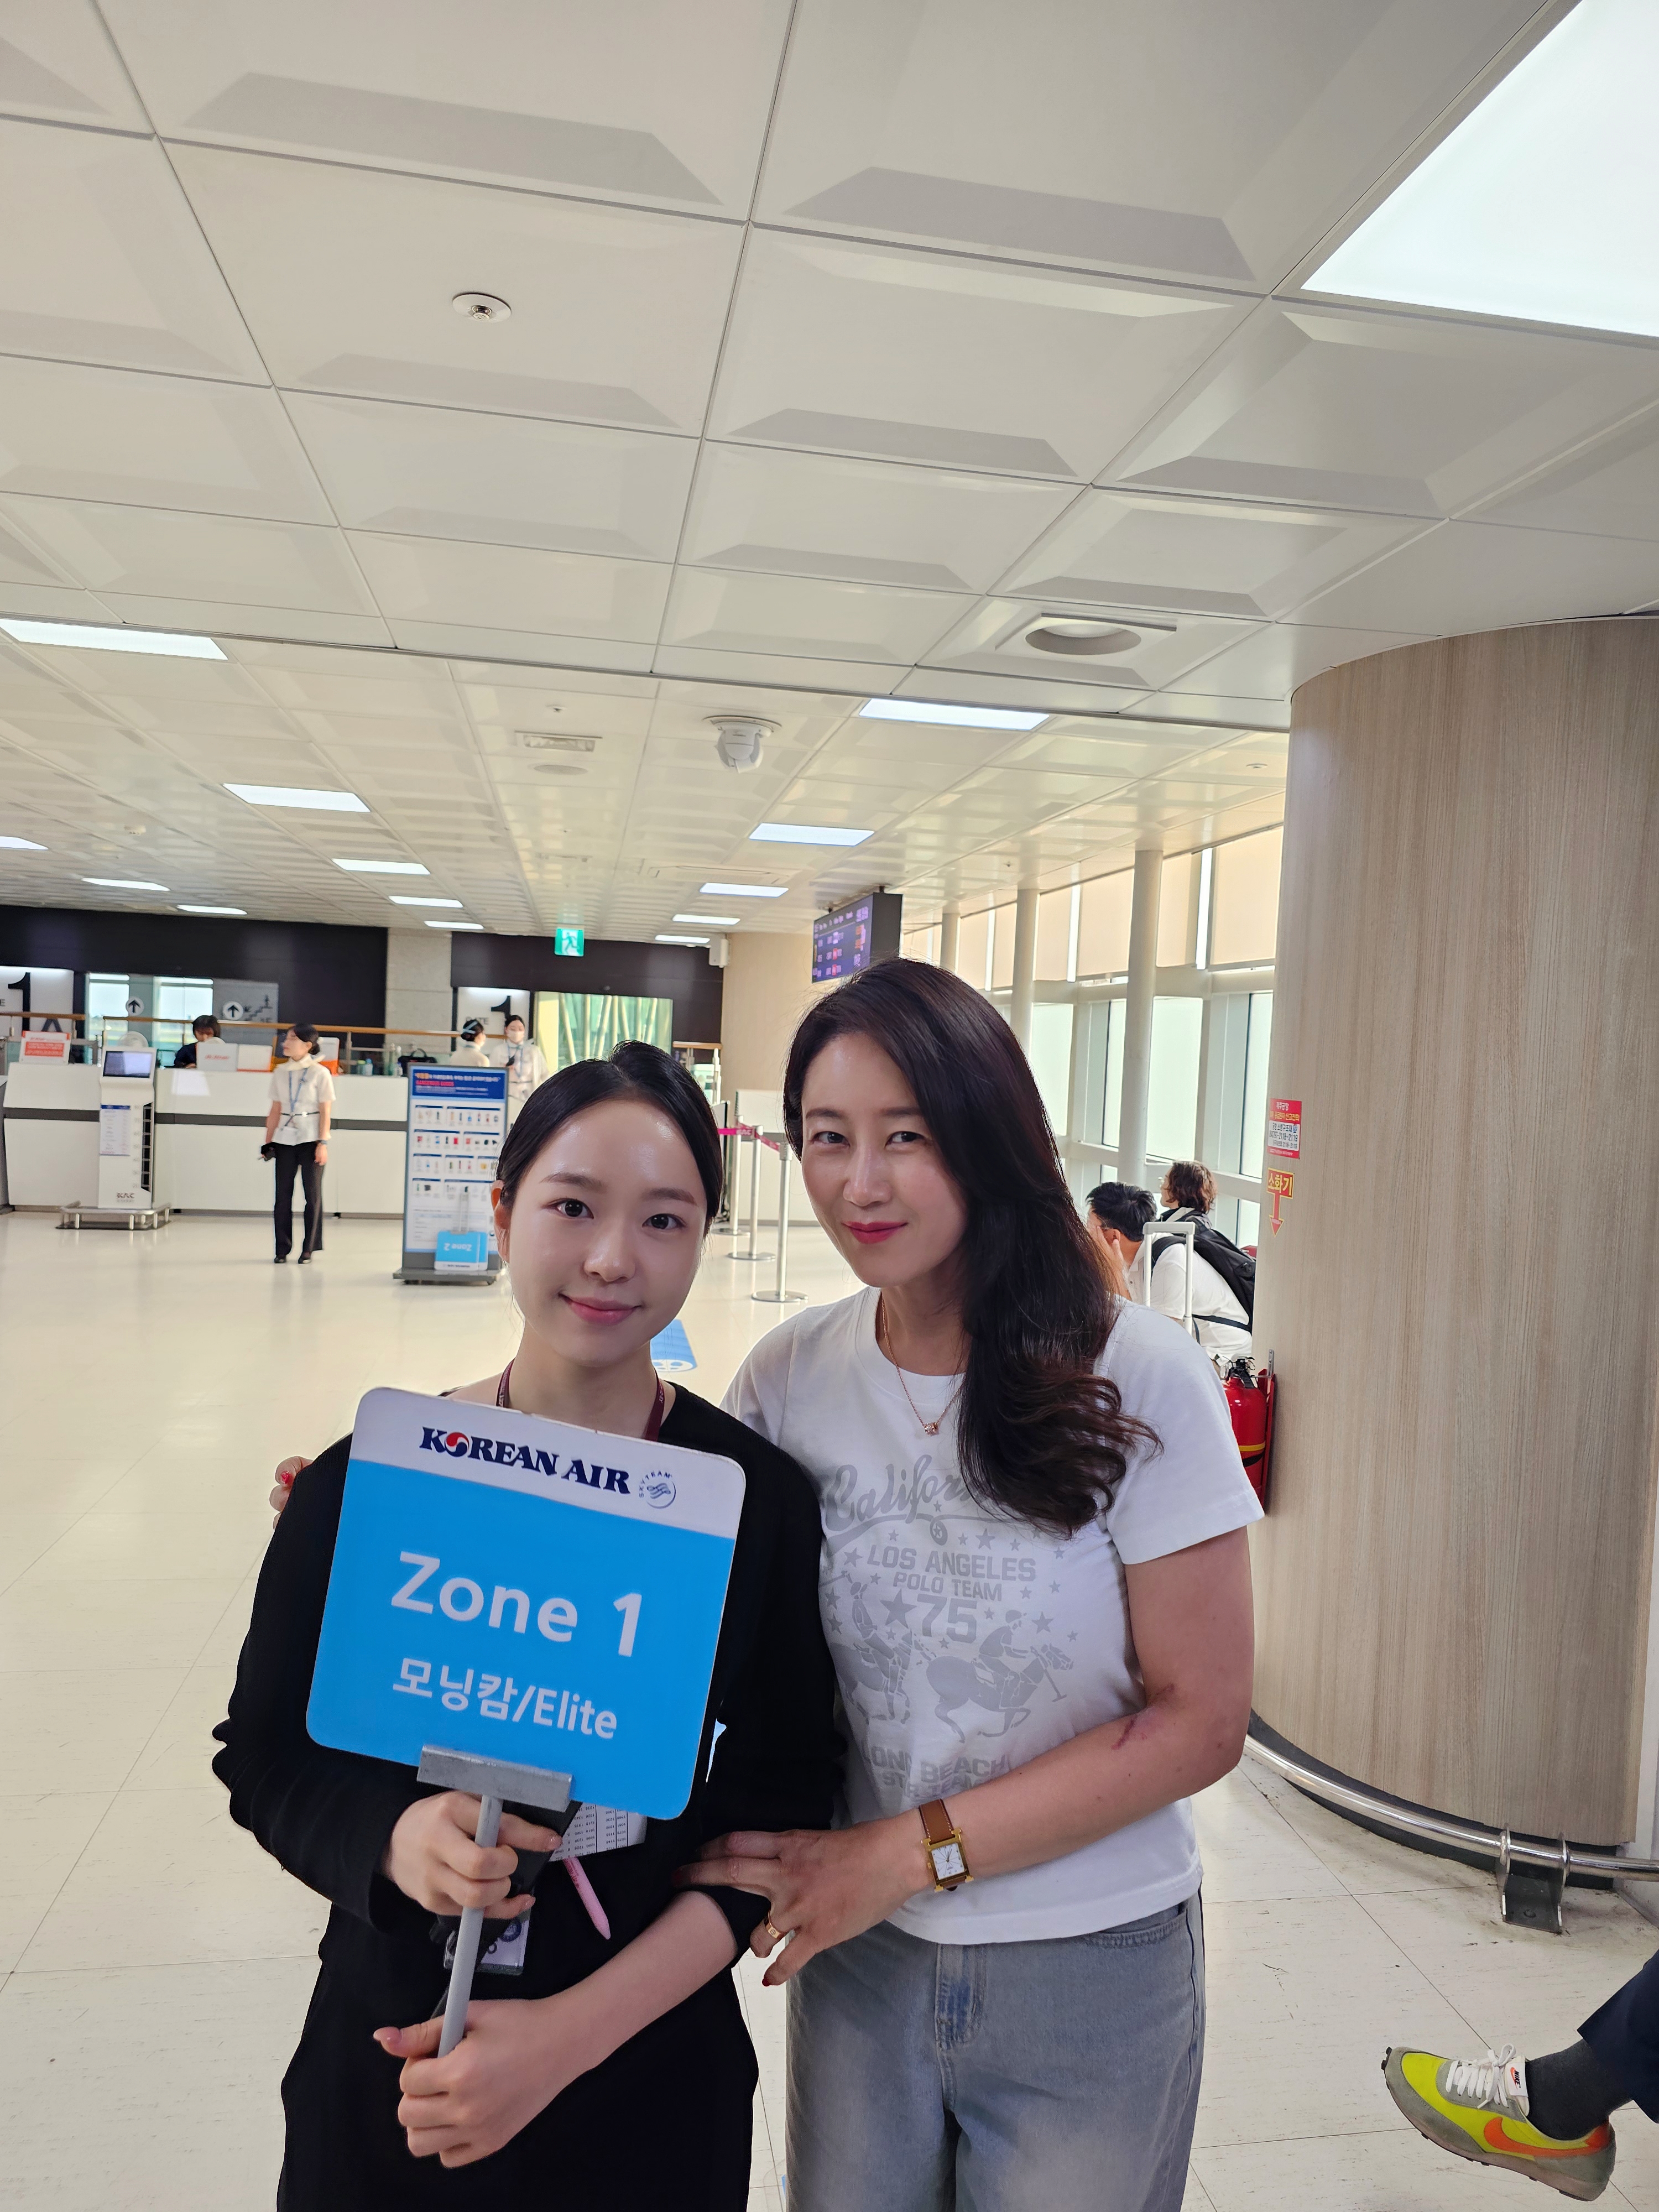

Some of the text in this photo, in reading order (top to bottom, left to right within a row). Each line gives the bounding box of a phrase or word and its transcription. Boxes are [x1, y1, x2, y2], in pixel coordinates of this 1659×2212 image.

[1267, 1172, 1293, 1196] 소화기
[444, 1243, 472, 1251] Zone 2
[419, 1426, 630, 1494] KOREAN AIR
[639, 1470, 672, 1498] SKYTEAM
[867, 1545, 1036, 1582] LOS ANGELES
[391, 1551, 643, 1657] Zone 1
[893, 1572, 1002, 1601] POLO TEAM
[917, 1594, 977, 1644] 75
[393, 1657, 617, 1739] 모닝캄/Elite
